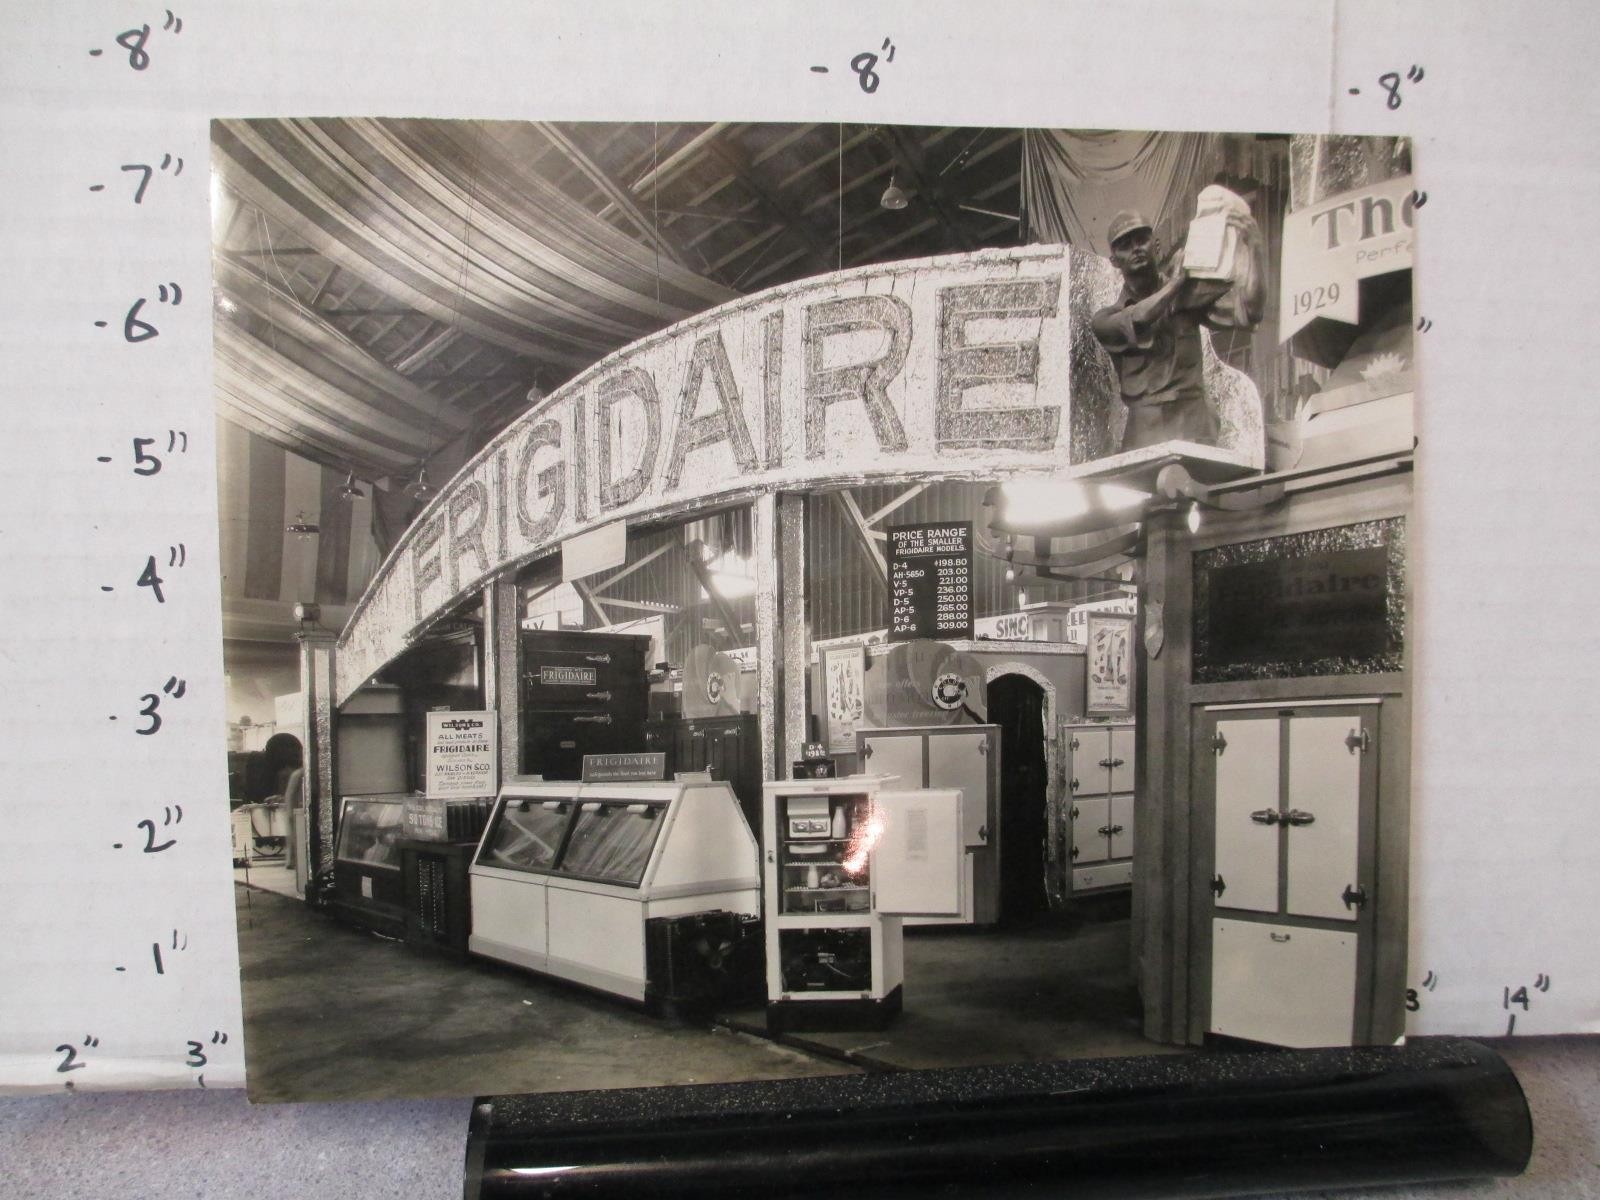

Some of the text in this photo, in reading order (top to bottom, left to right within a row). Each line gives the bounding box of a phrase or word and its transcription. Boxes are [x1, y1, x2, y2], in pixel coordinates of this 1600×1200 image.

[1293, 282, 1340, 316] 1929
[411, 273, 1062, 621] FRIGIDAIRE
[893, 528, 967, 541] PRICE RANGE
[910, 539, 924, 547] THE
[928, 538, 962, 546] SMALLER
[895, 546, 933, 555] FRIGIDAIRE
[937, 567, 967, 576] 203.00
[893, 585, 967, 597] VP-5 236.00
[937, 594, 968, 603] 250.00
[894, 606, 915, 614] AP-5
[894, 621, 968, 632] AP-6 309.00
[543, 670, 595, 681] FRIGIDAIRE
[455, 732, 483, 740] MEATS
[433, 744, 490, 754] FRIGIDAIRE
[589, 757, 656, 766] FRIGIDAIRE
[436, 764, 472, 772] WILSON
